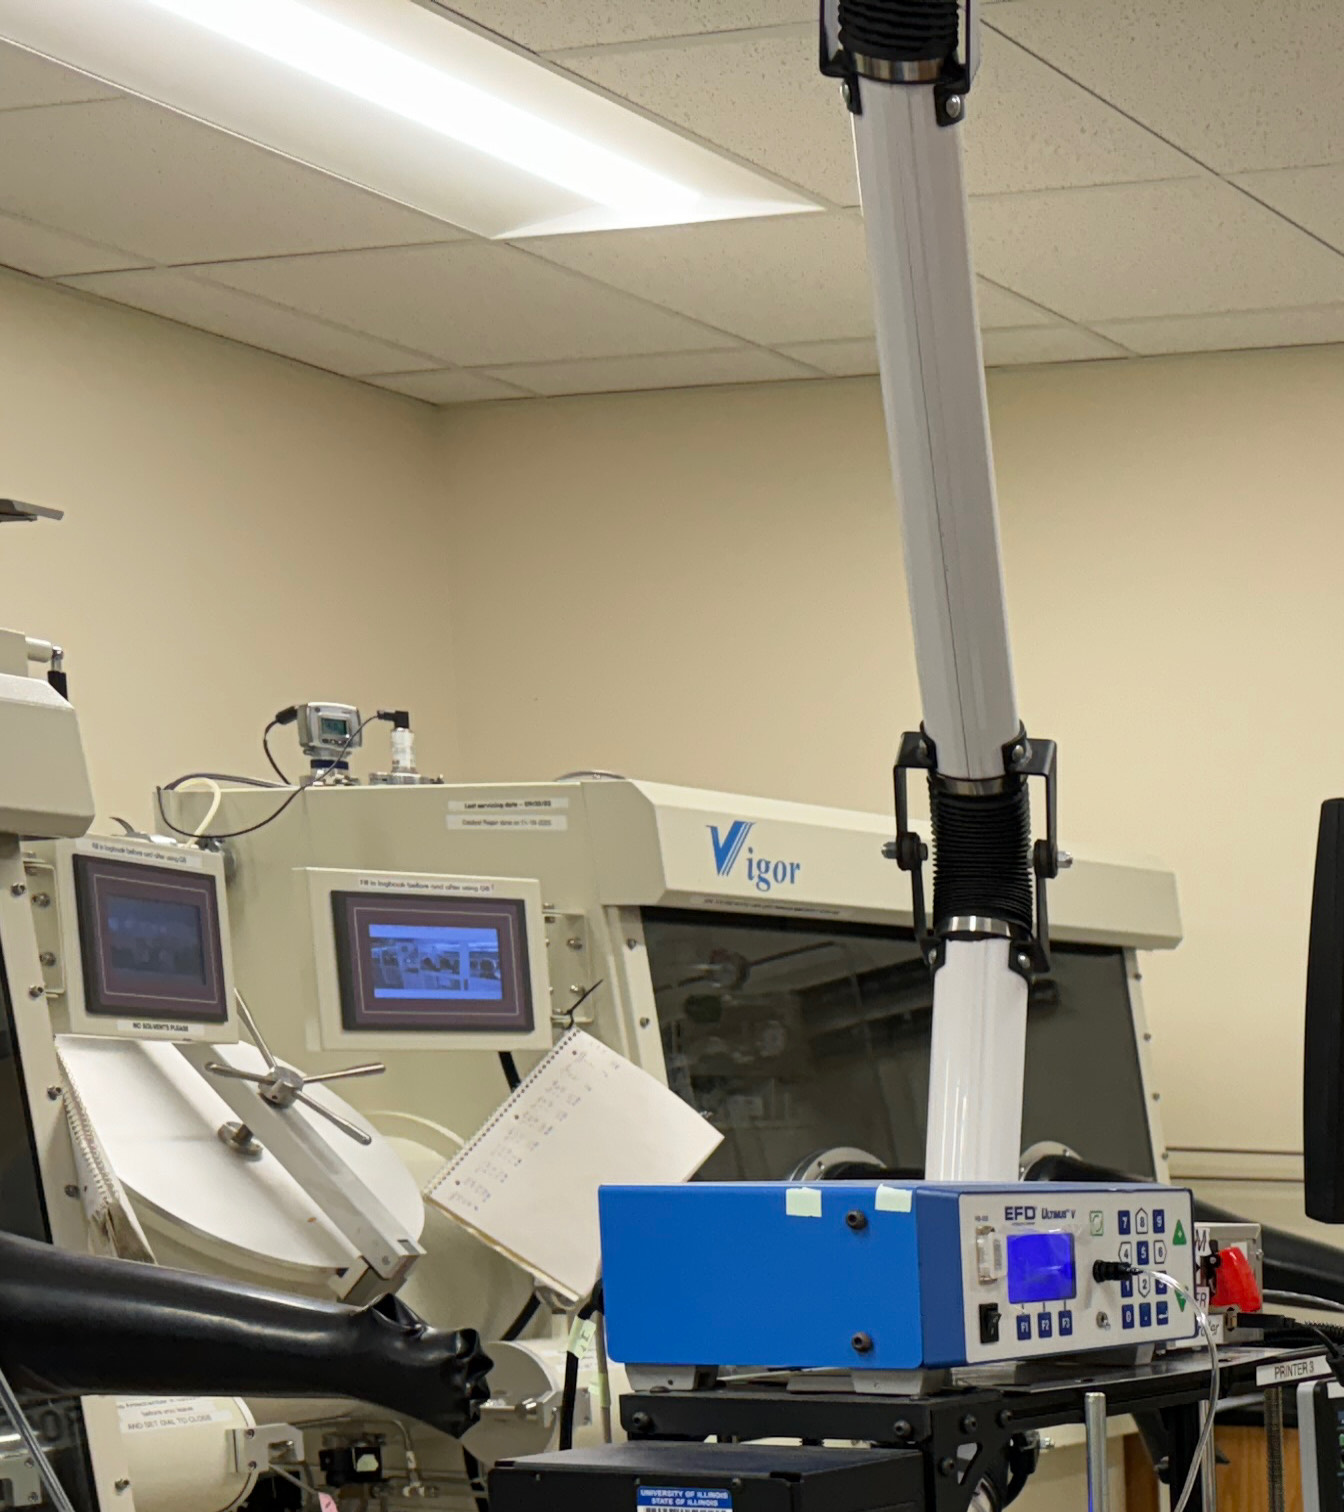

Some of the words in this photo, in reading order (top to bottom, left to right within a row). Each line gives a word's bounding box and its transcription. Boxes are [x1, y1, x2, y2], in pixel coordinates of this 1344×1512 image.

[705, 820, 800, 892] Vigor
[1004, 1206, 1035, 1221] EFD
[1069, 1210, 1076, 1219] V
[1123, 1248, 1129, 1259] 4
[1140, 1247, 1147, 1258] 5
[1158, 1248, 1164, 1257] 6
[1142, 1279, 1148, 1290] 2
[1126, 1311, 1132, 1322] 0
[1020, 1322, 1029, 1332] F1
[1041, 1319, 1050, 1330] F2
[1062, 1317, 1070, 1329] F3
[1274, 1362, 1308, 1379] PRINTER
[1309, 1360, 1315, 1374] 3
[127, 1422, 143, 1430] AND
[144, 1420, 158, 1428] SET
[160, 1418, 176, 1427] DIAL
[188, 1414, 212, 1423] CLOSE
[640, 1489, 683, 1498] UNIVERSITY
[685, 1490, 695, 1498] OF
[697, 1491, 729, 1499] ILLINOIS
[675, 1498, 685, 1506] OF
[687, 1499, 719, 1507] ILLINOIS
